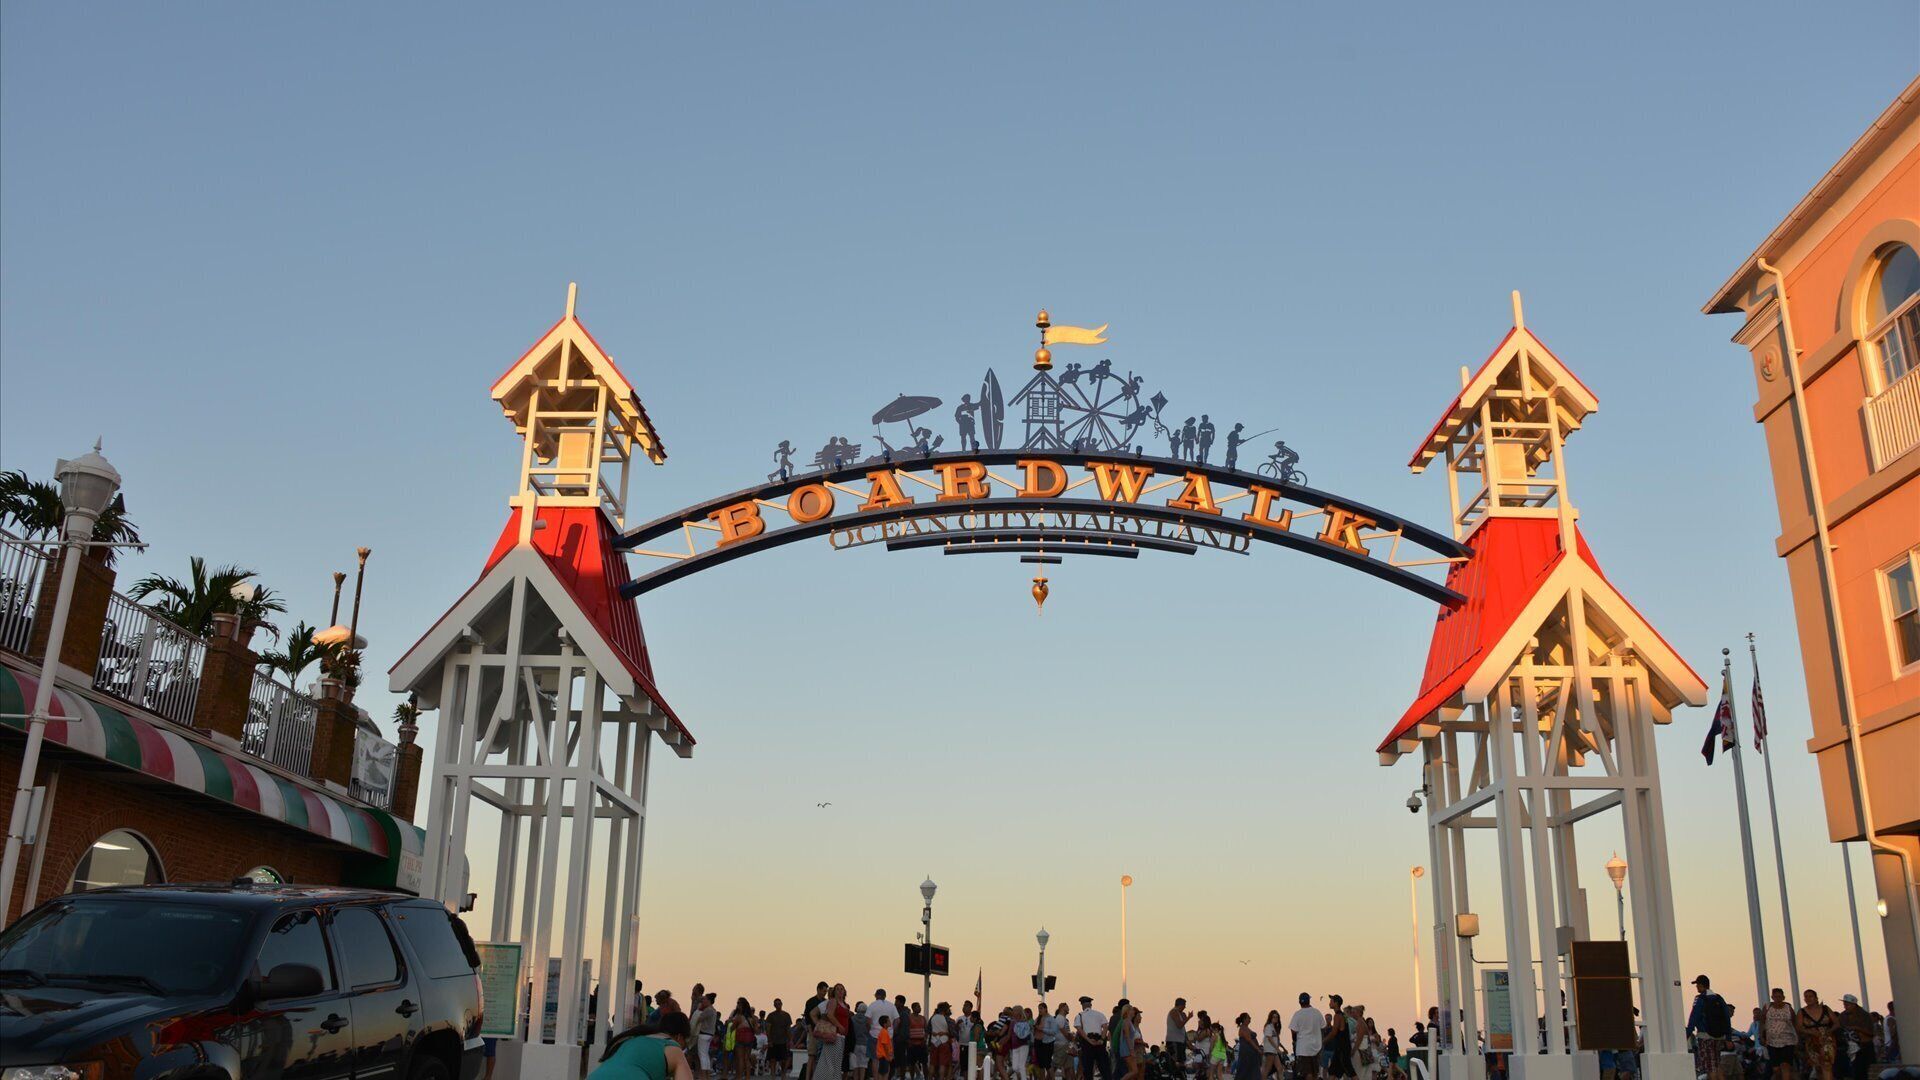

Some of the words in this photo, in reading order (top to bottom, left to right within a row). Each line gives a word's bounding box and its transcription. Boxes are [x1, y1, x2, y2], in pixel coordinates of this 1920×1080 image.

[707, 459, 1377, 556] BOARDWALK
[829, 513, 949, 548] OCEAN
[1053, 511, 1250, 553] MARYLAND
